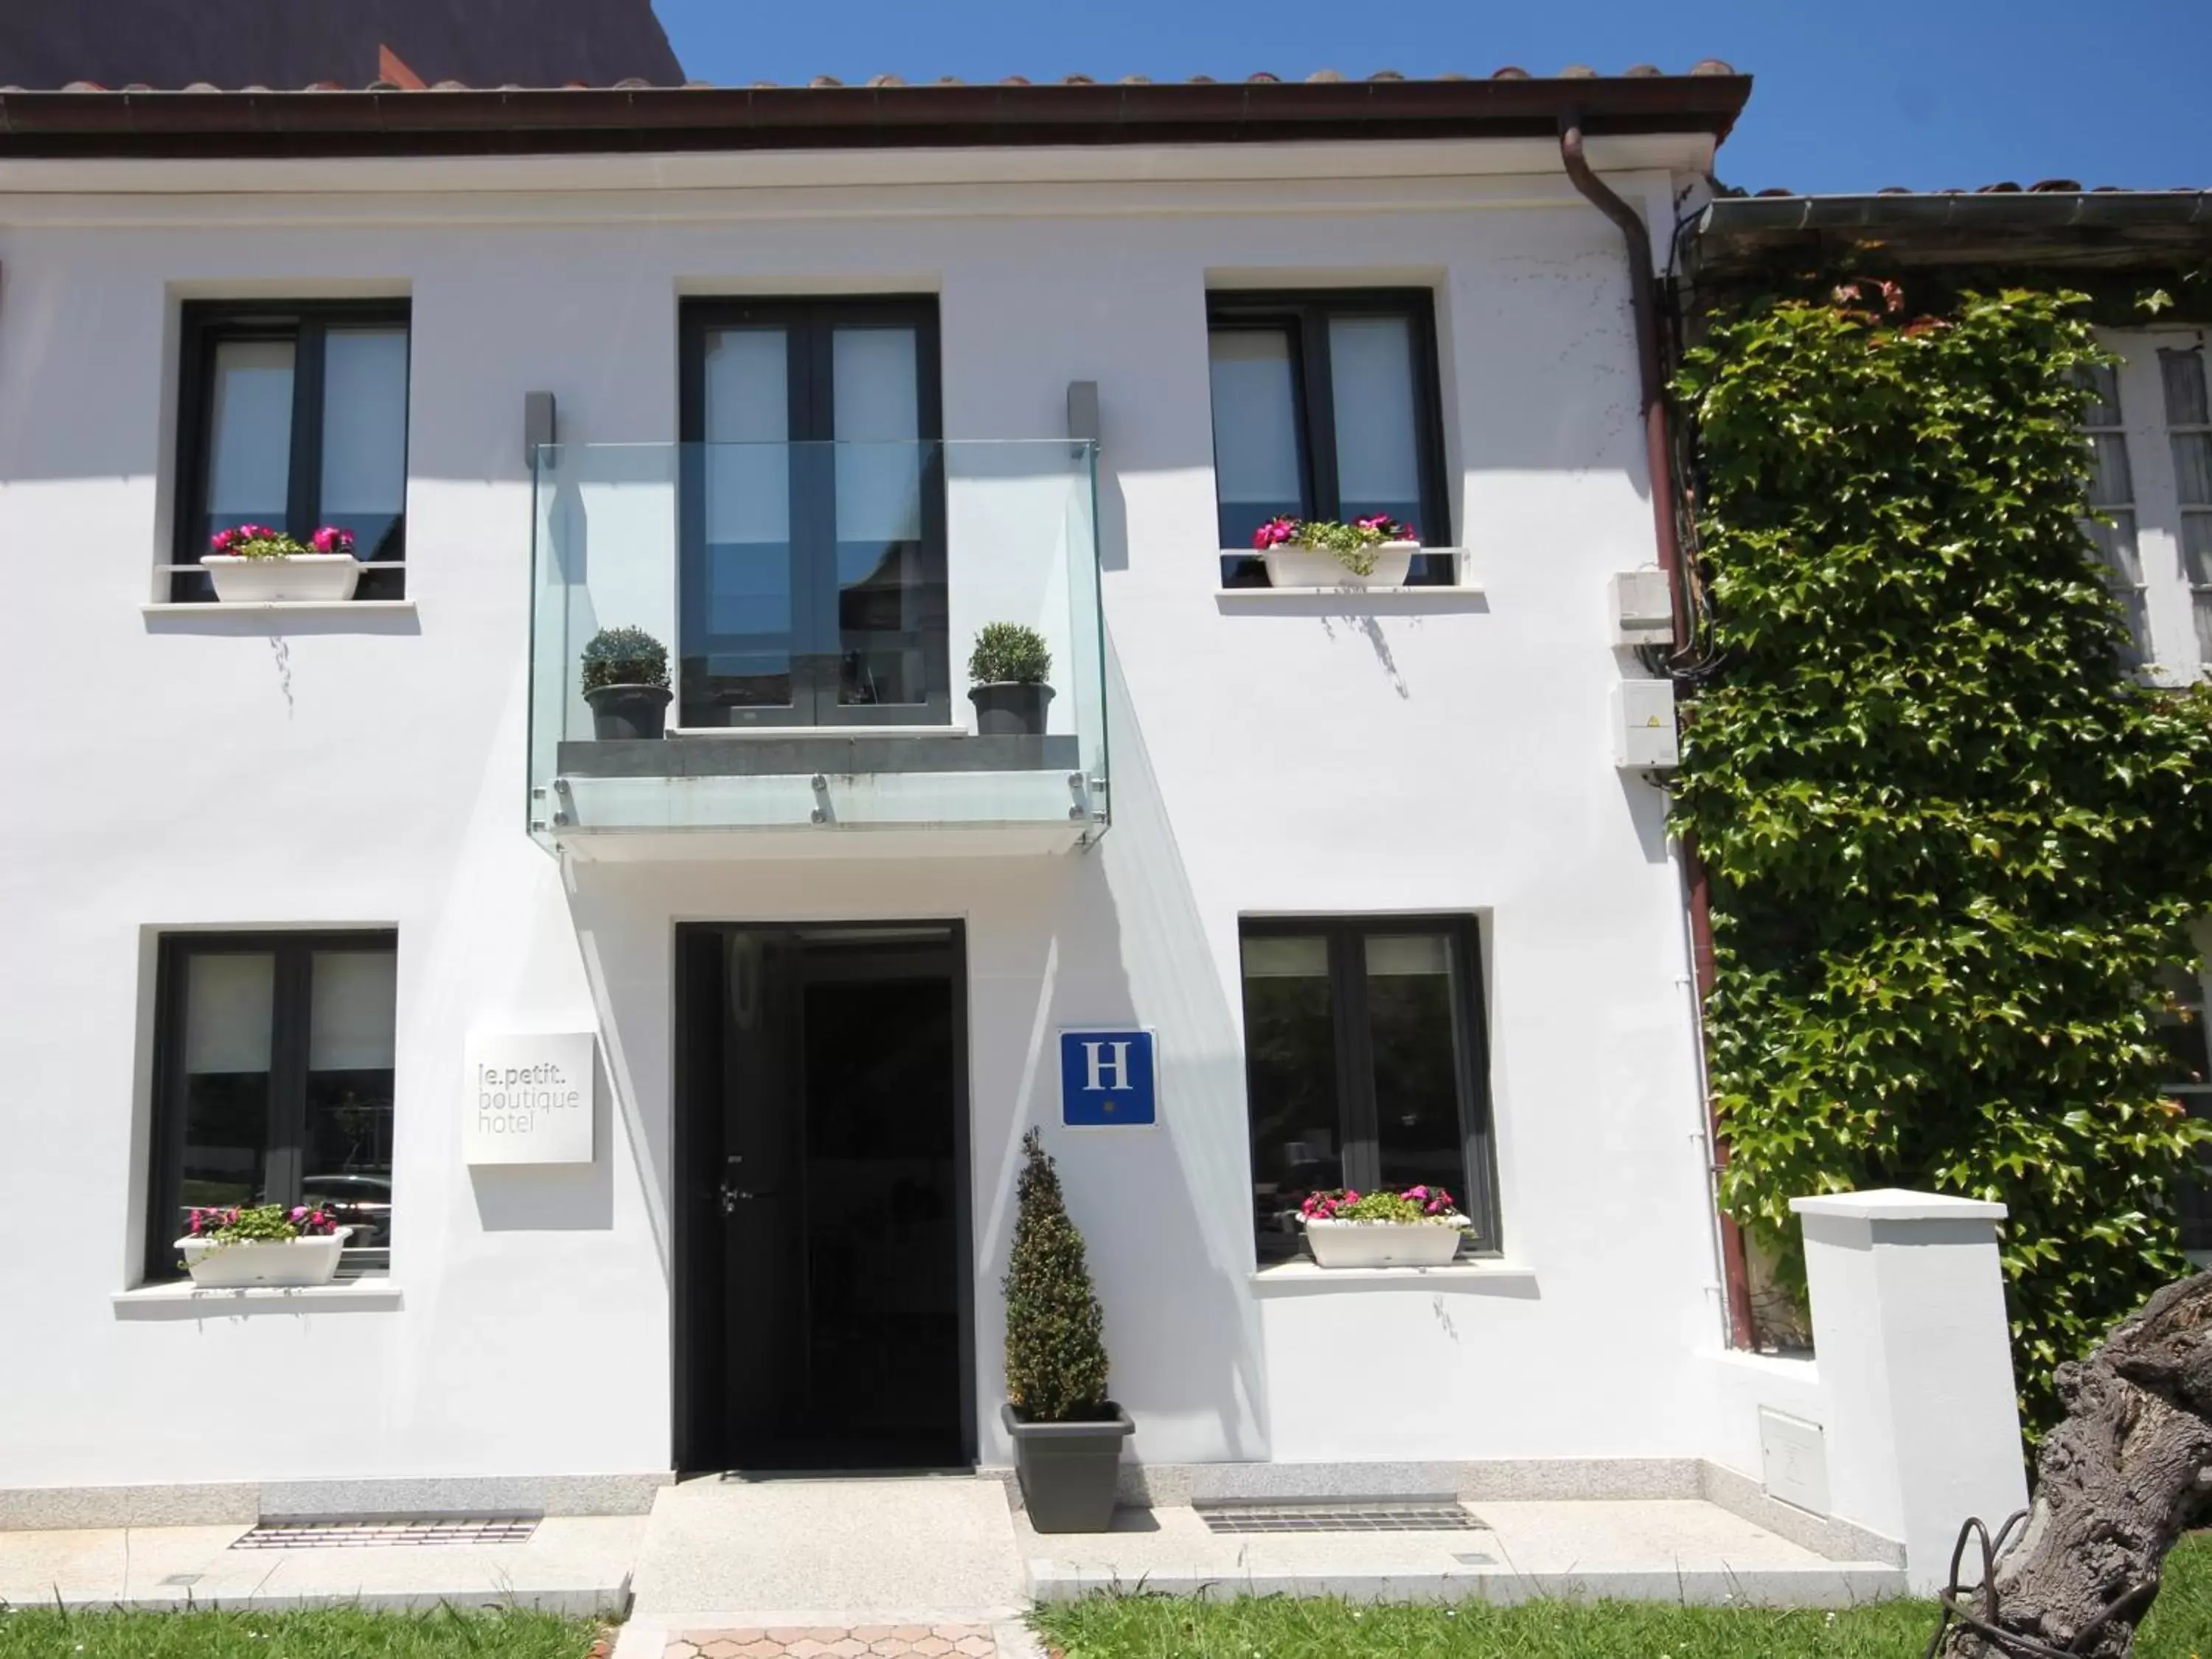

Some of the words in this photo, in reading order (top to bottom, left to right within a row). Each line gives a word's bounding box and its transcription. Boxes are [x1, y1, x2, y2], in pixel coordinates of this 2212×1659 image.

[1080, 1041, 1133, 1091] H
[479, 1087, 580, 1115] boutique
[479, 1110, 535, 1133] hotel
